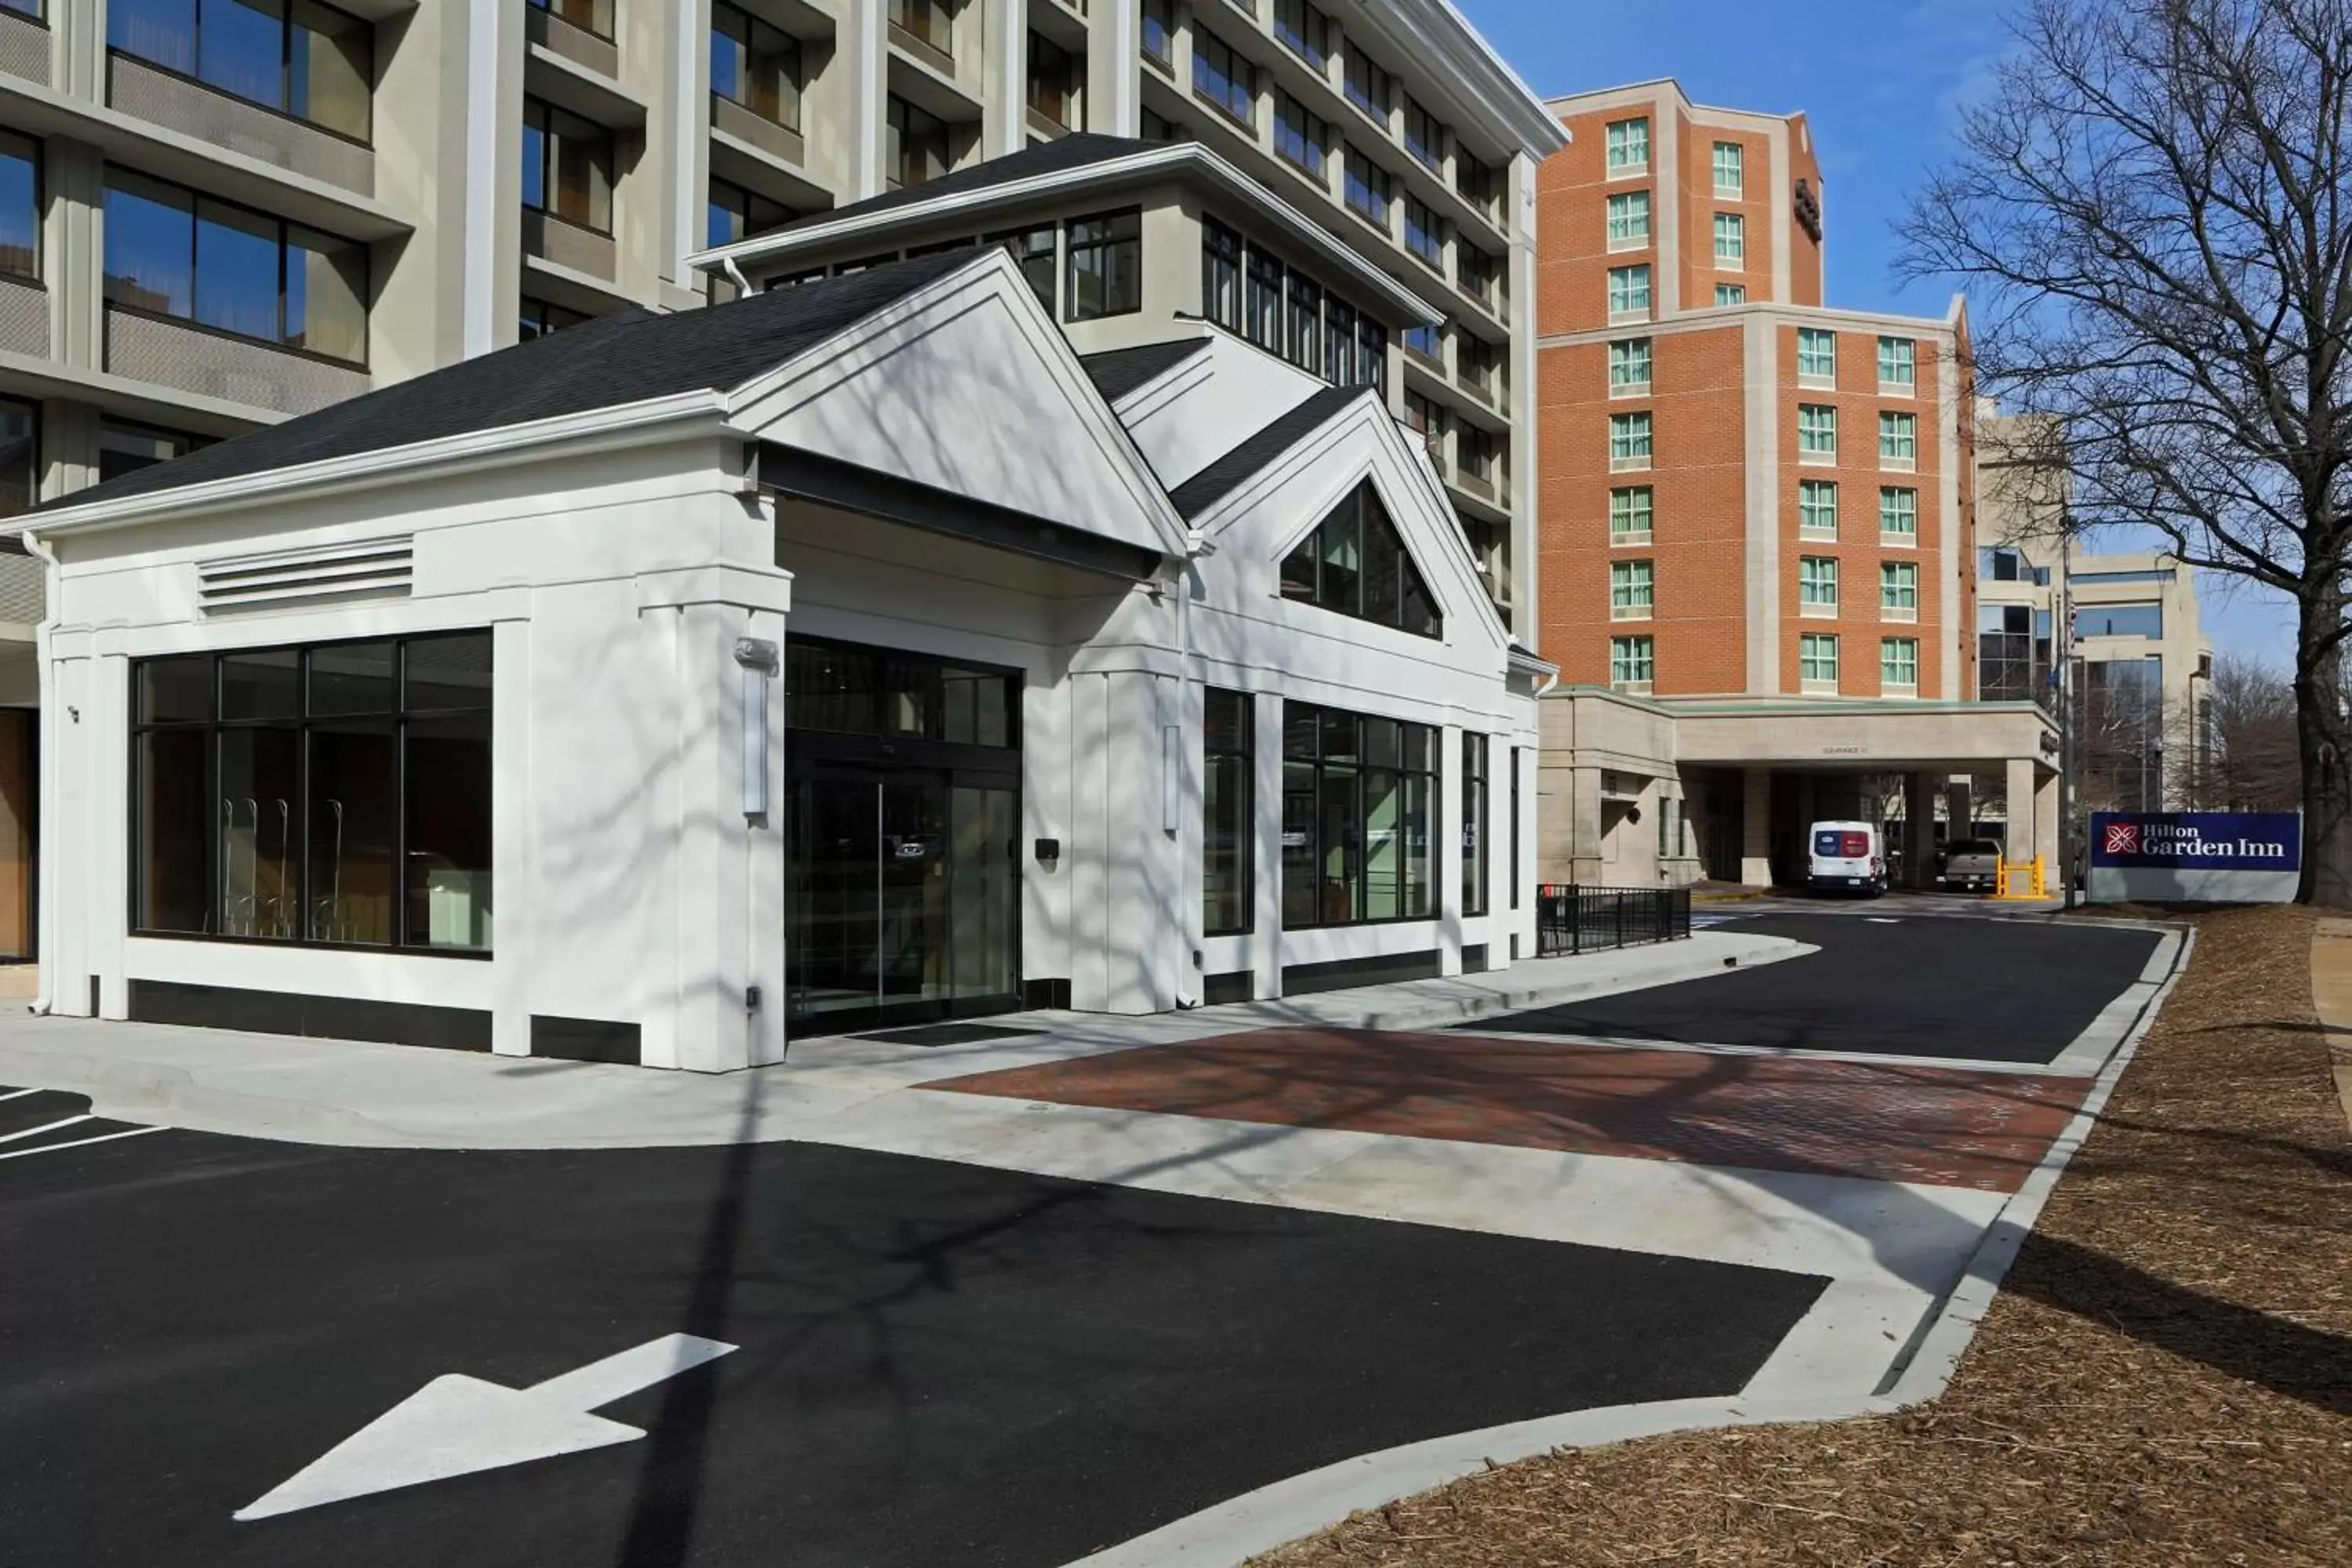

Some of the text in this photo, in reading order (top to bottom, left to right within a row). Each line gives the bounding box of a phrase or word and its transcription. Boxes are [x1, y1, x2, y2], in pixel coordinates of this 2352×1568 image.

[2143, 824, 2198, 837] Hilton
[2142, 838, 2285, 857] Garden Inn
